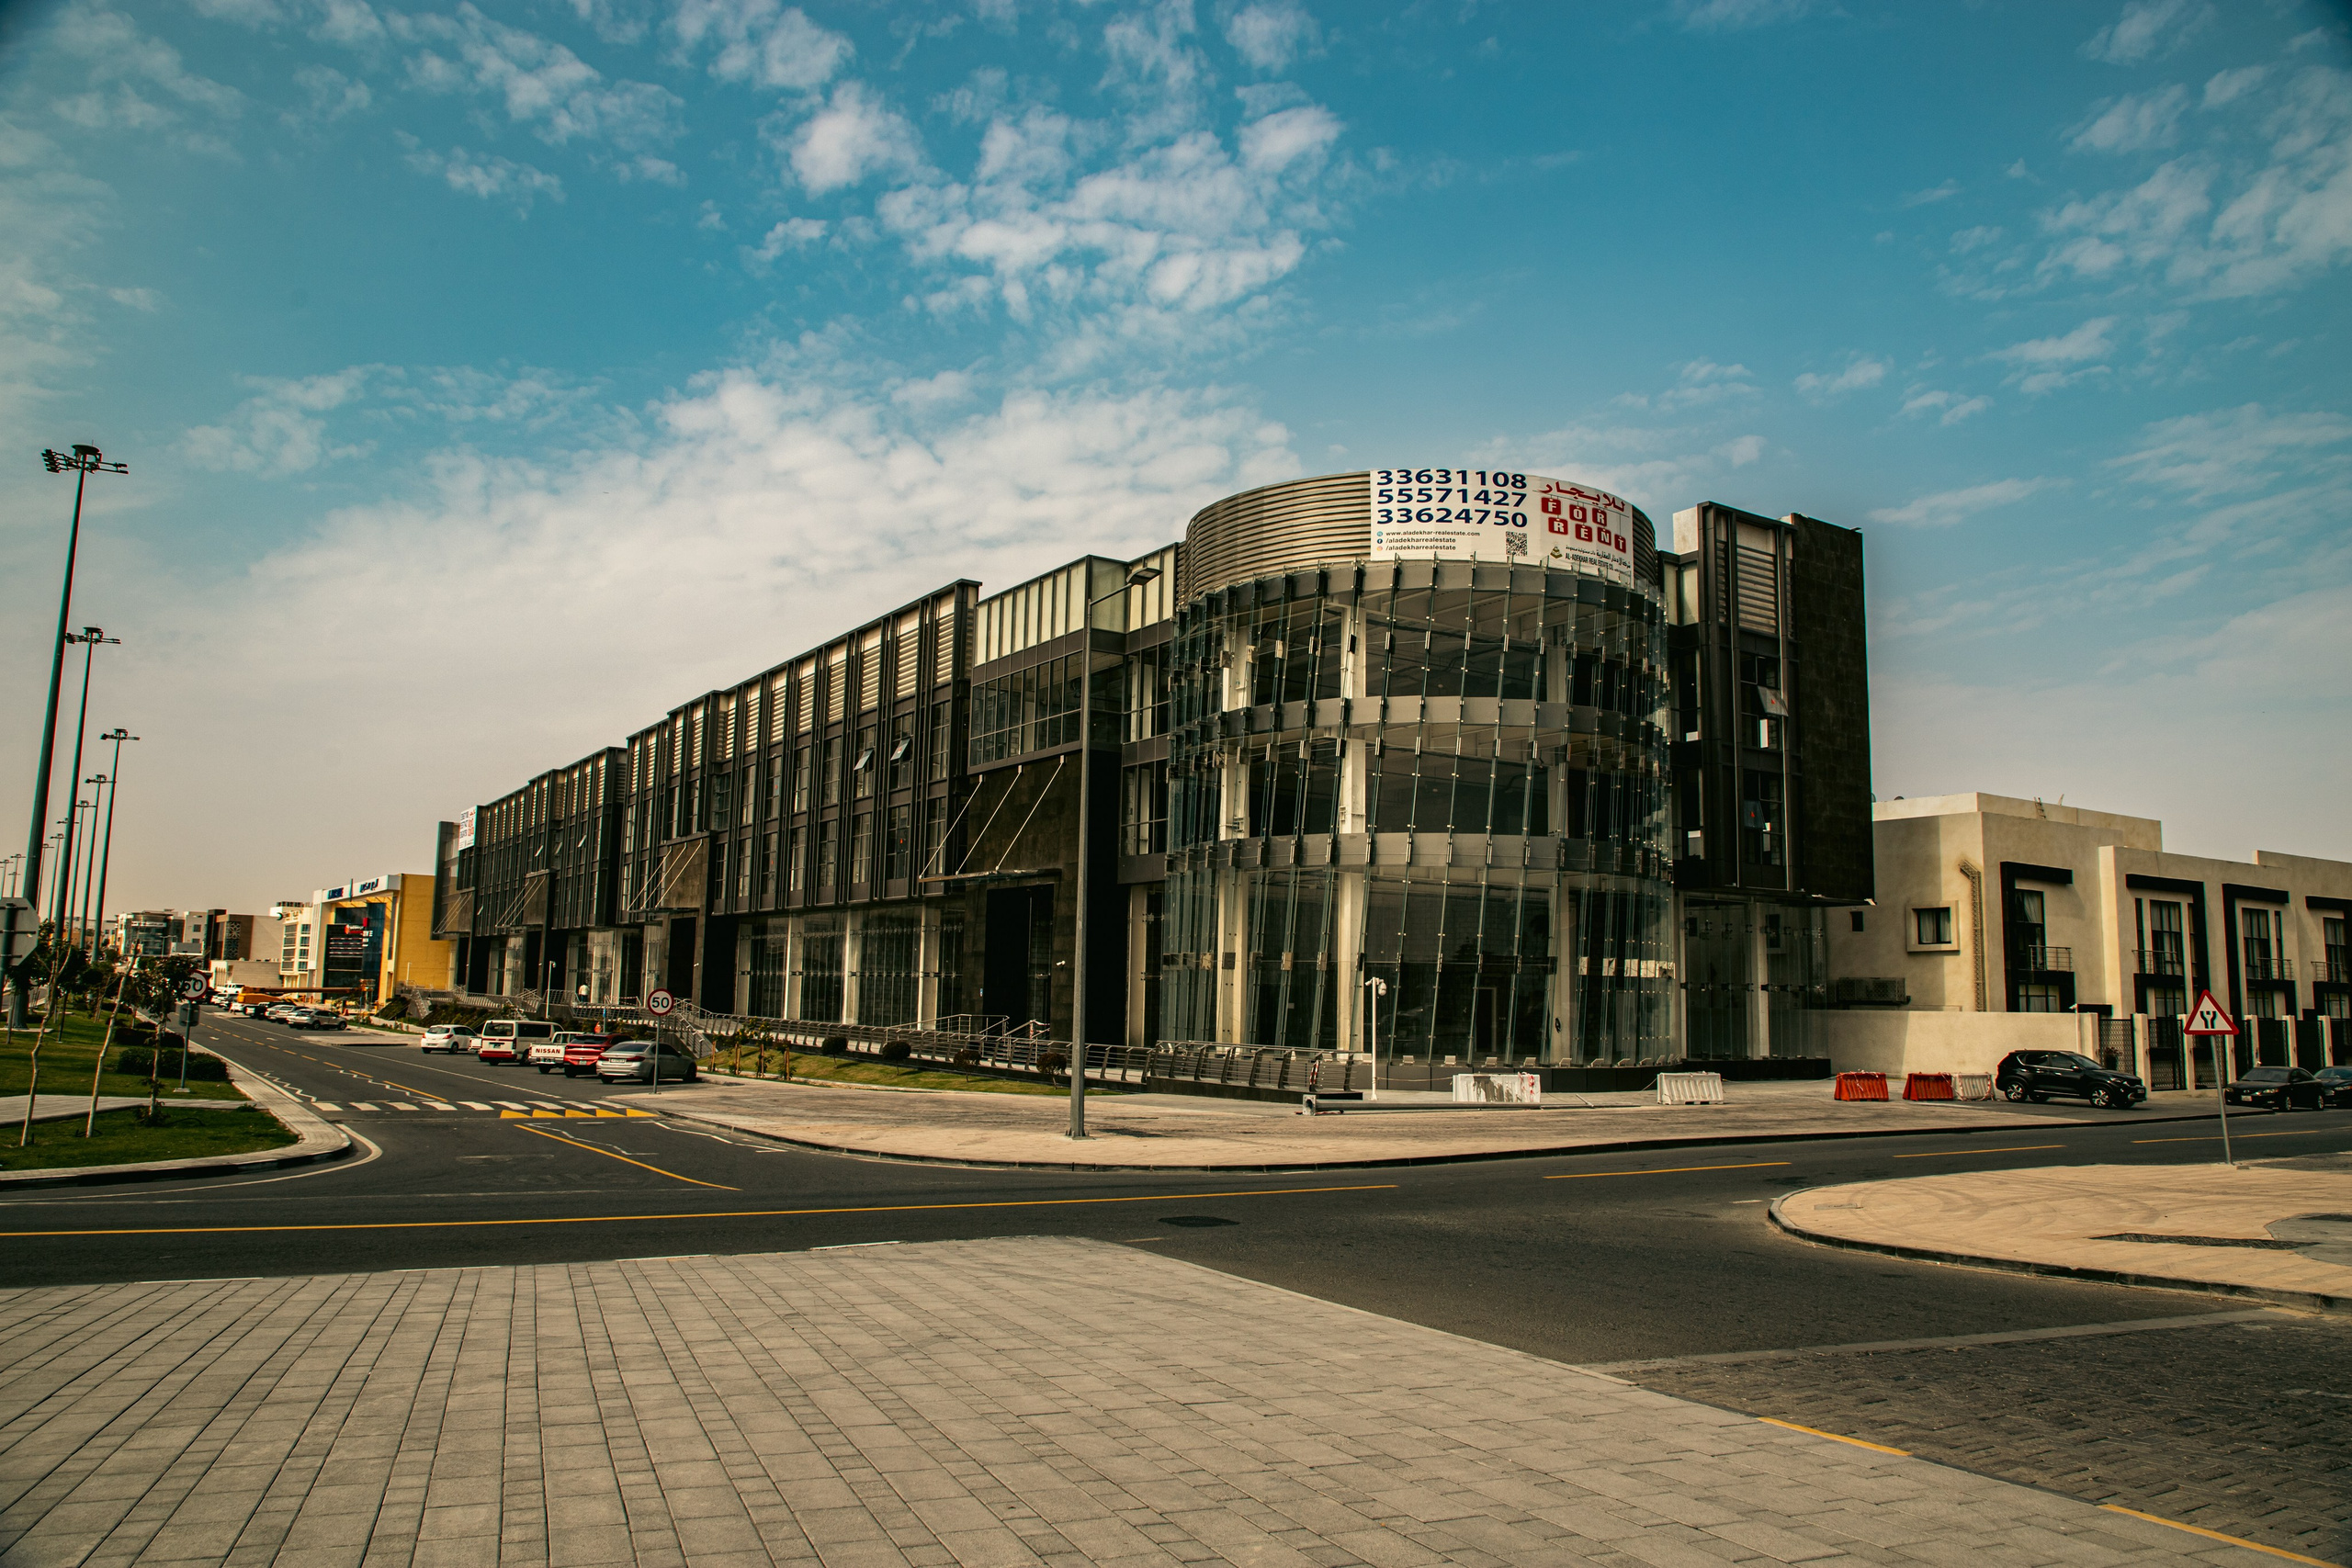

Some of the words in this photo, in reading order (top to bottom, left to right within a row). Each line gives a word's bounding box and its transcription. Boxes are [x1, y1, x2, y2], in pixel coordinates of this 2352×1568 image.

[1376, 468, 1528, 490] 33631108
[1376, 488, 1528, 508] 55571427
[1376, 507, 1528, 528] 33624750
[1546, 501, 1605, 525] FOR
[1553, 520, 1624, 553] RENT
[1589, 557, 1598, 566] REAL
[651, 997, 670, 1009] 50
